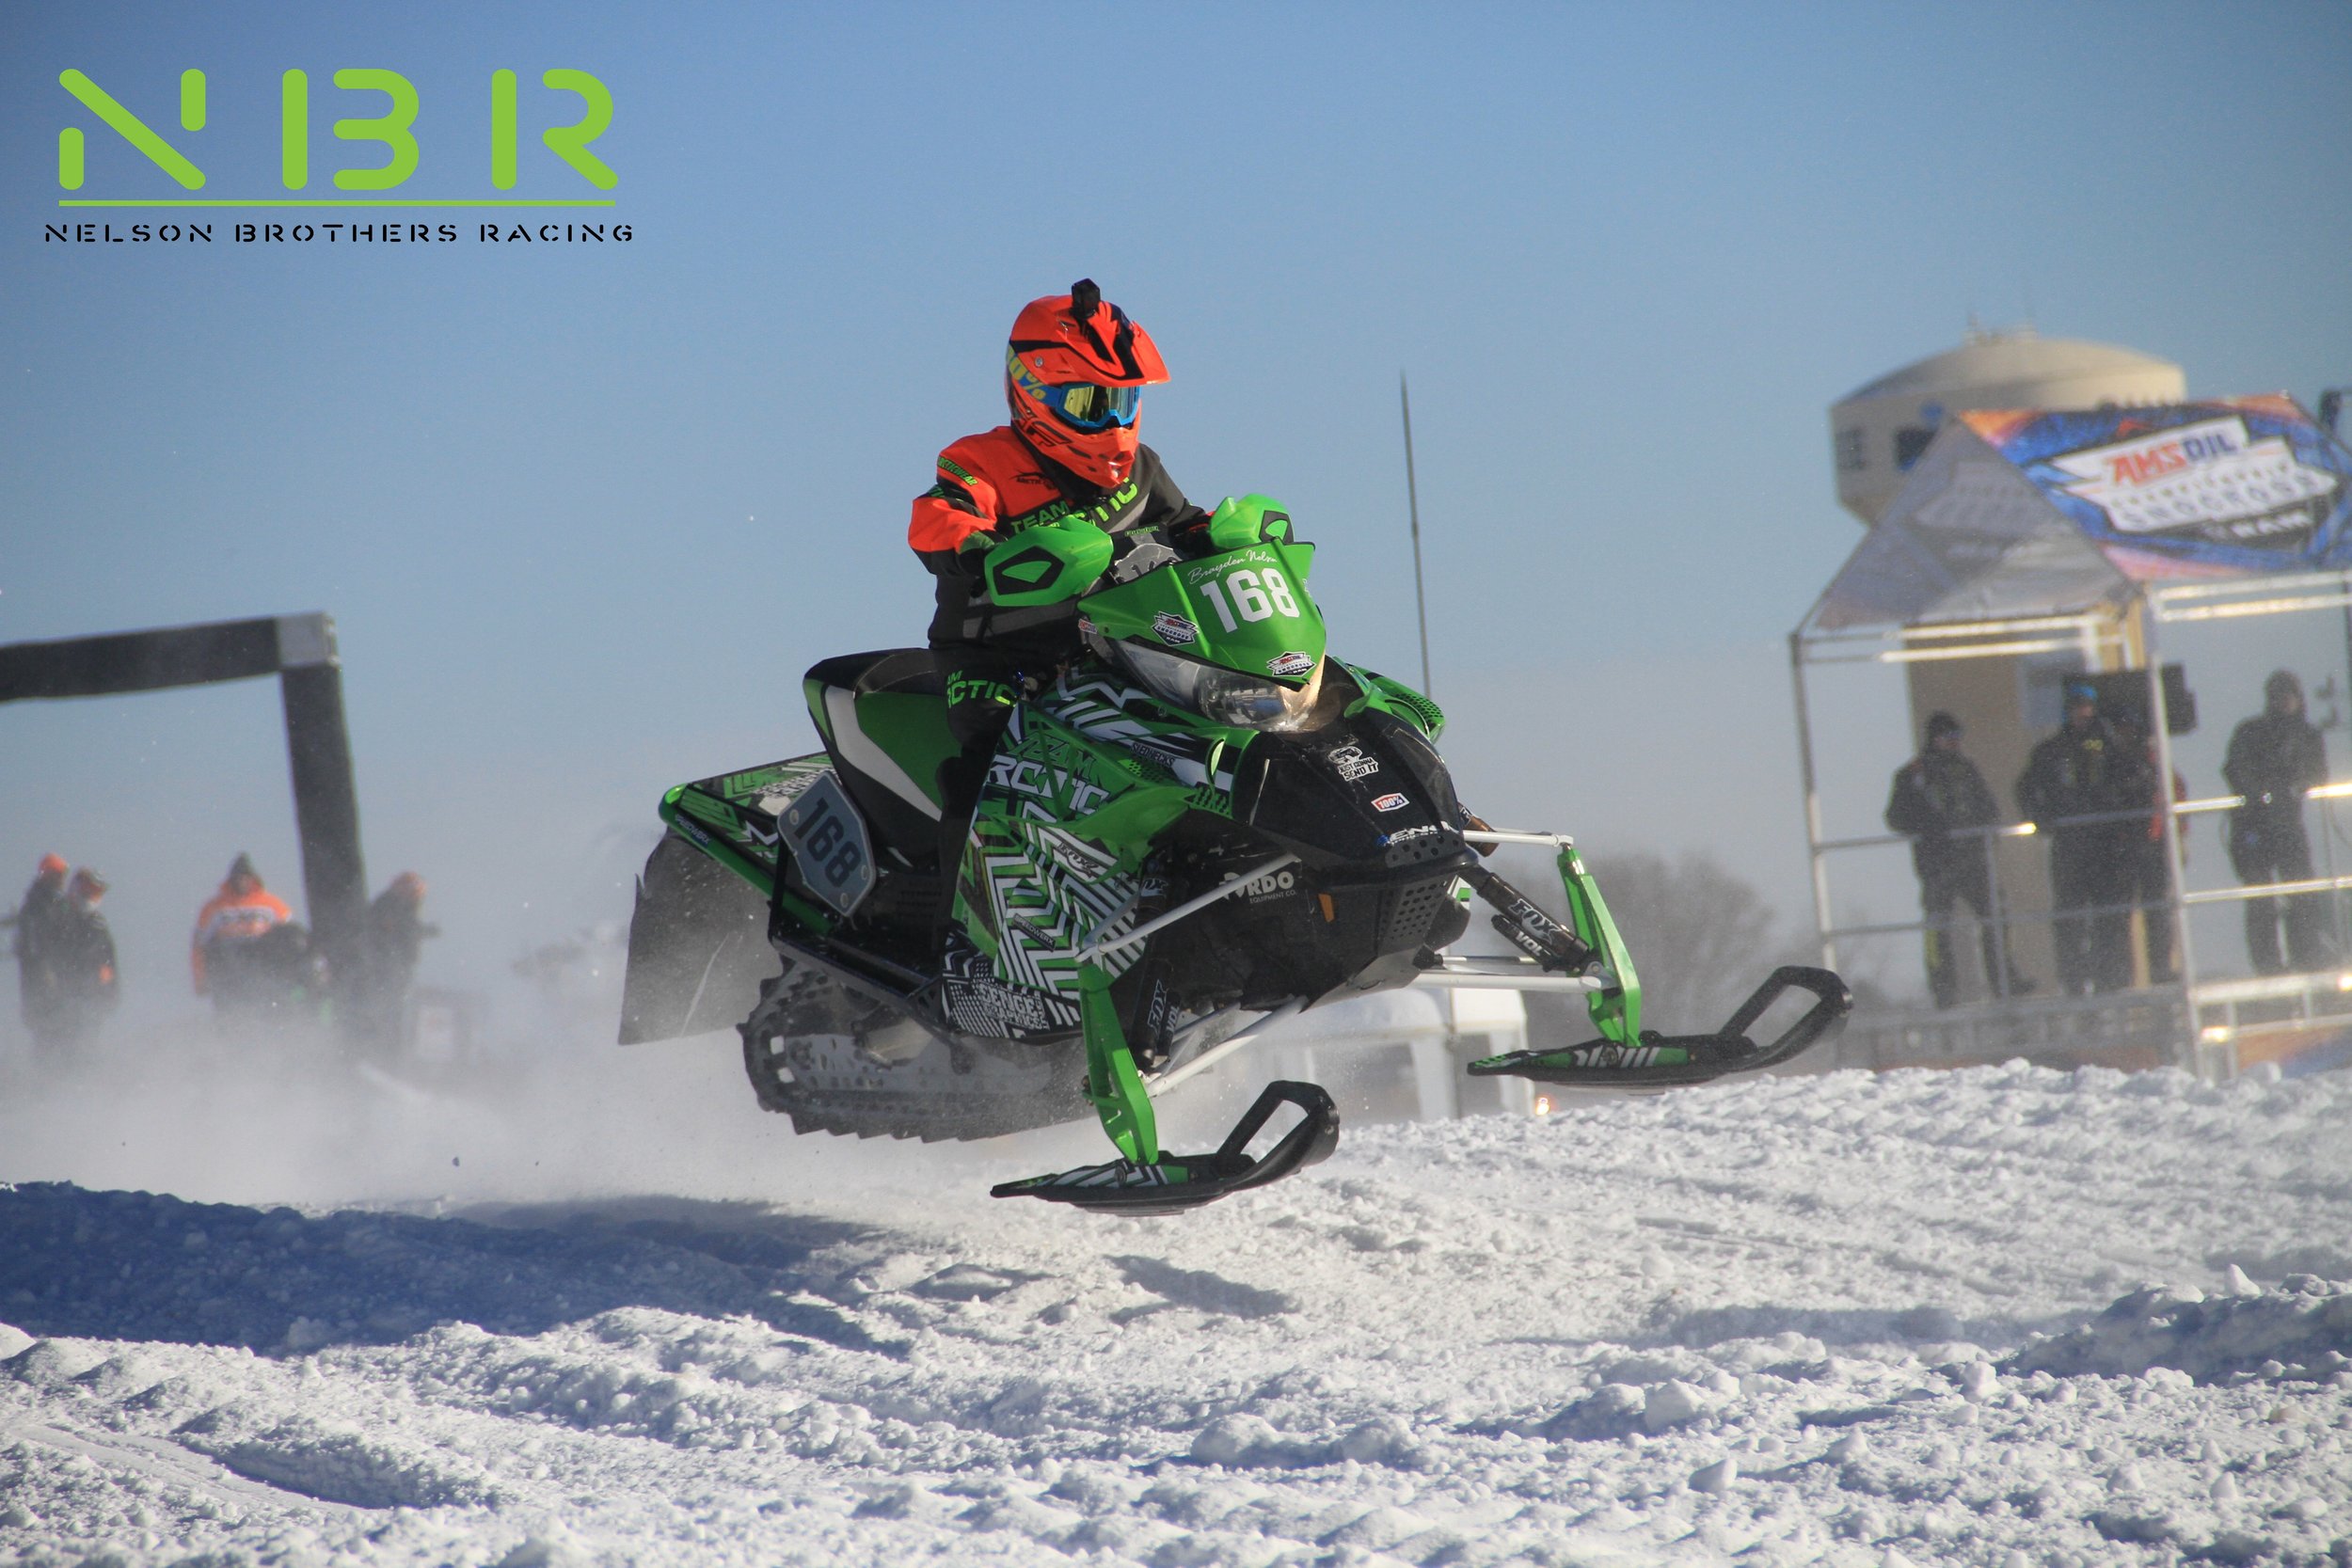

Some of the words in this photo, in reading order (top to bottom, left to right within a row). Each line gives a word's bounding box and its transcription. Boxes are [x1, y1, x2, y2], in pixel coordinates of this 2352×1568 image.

[2106, 432, 2238, 486] AMSOIL
[1010, 500, 1070, 535] TEAM
[1200, 567, 1300, 634] 168
[946, 679, 1017, 708] CTIC
[987, 753, 1111, 816] RCTIC
[1343, 766, 1366, 780] SEND
[1368, 763, 1377, 772] IT
[1377, 796, 1404, 810] 100%
[794, 797, 862, 888] 168
[1507, 897, 1563, 946] FOX
